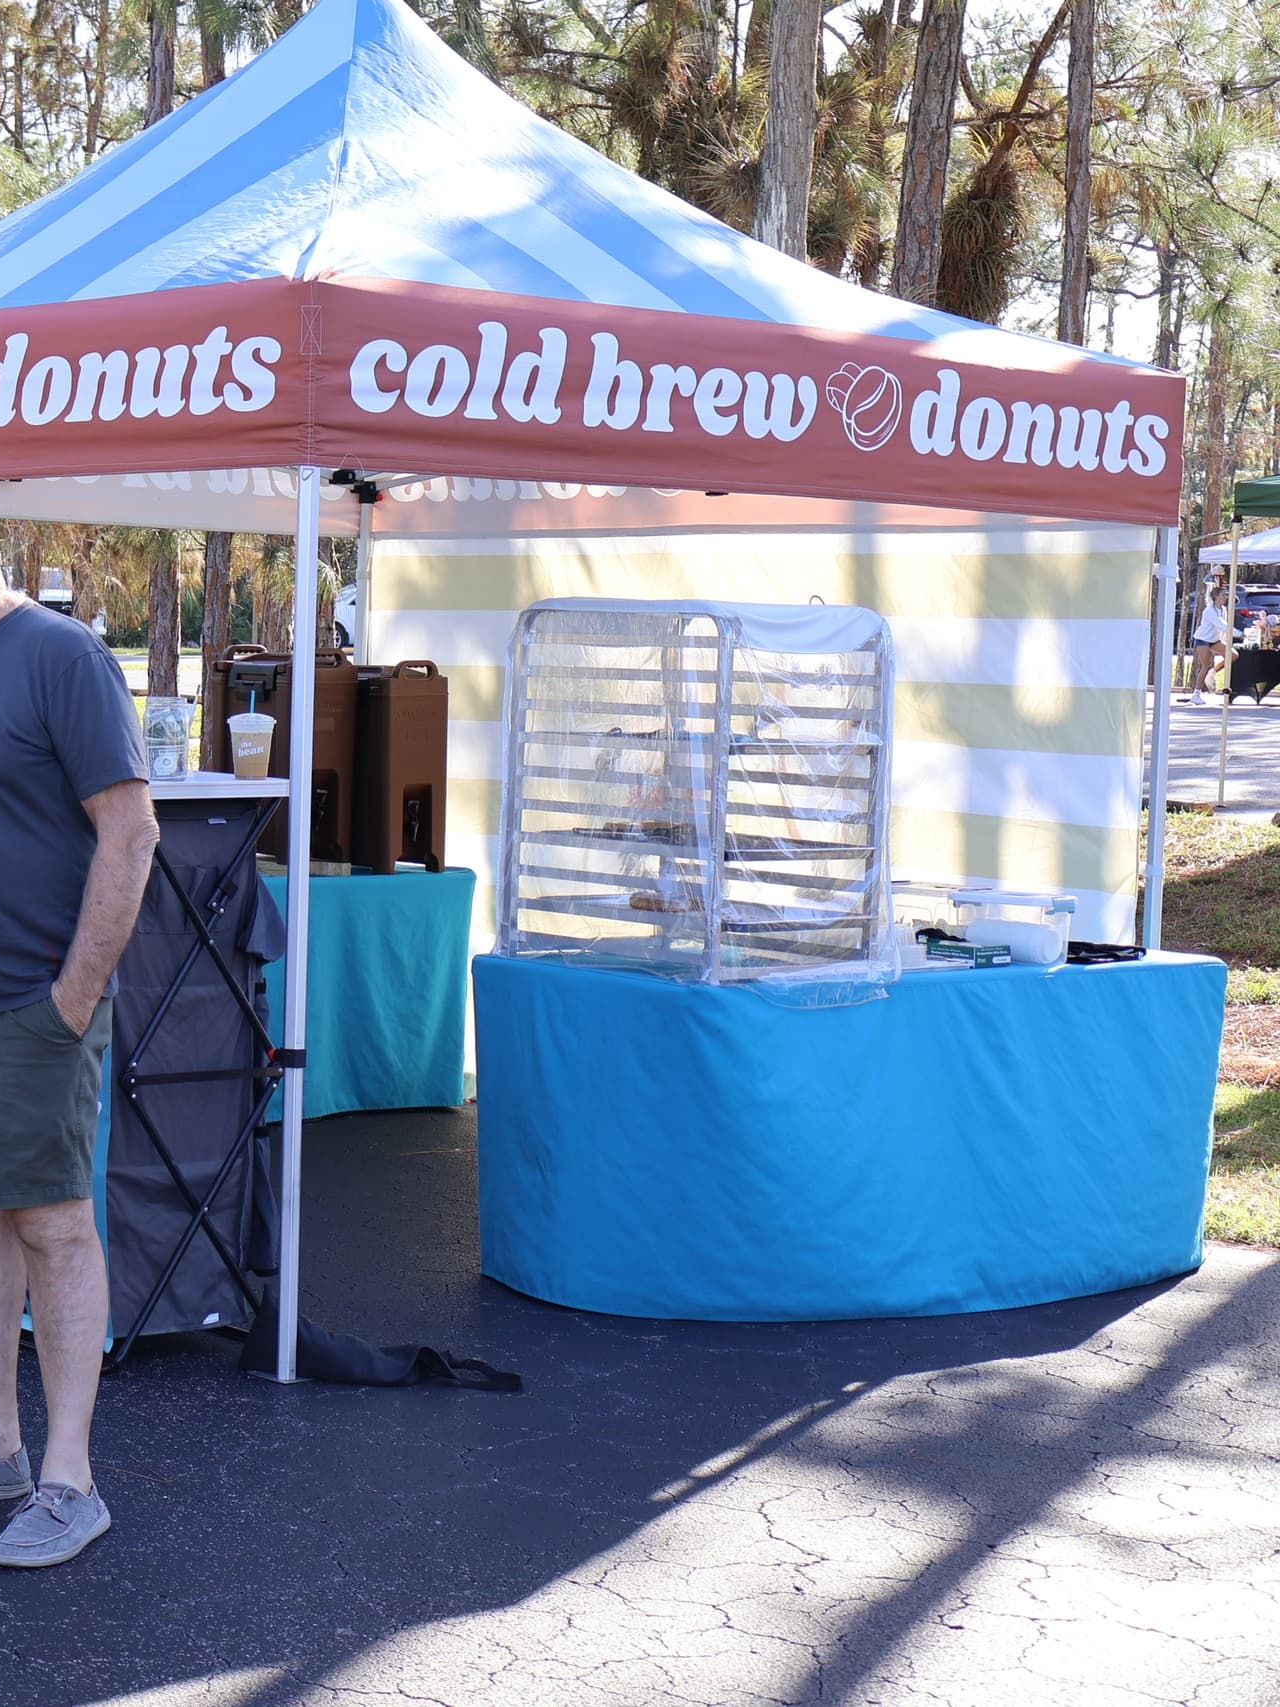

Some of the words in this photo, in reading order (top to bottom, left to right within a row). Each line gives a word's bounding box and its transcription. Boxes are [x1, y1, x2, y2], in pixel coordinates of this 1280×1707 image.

[350, 321, 567, 424] cold
[583, 332, 818, 441] brew
[909, 368, 1170, 476] donuts
